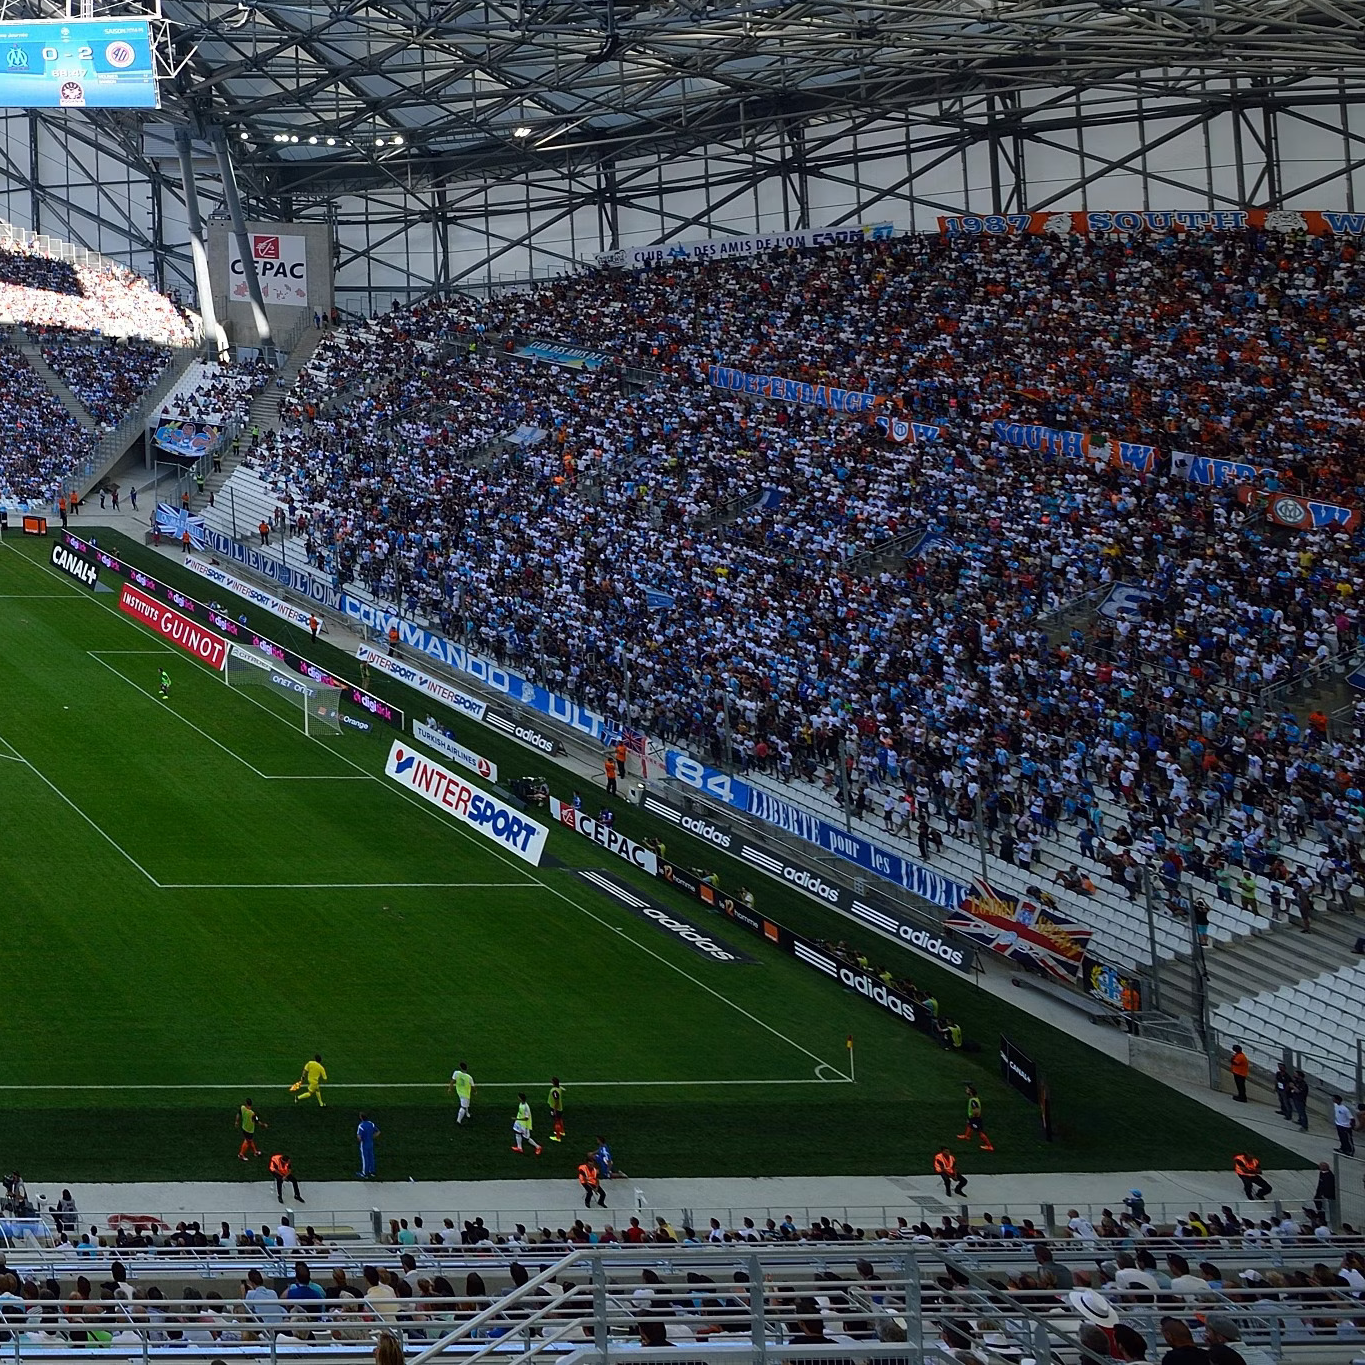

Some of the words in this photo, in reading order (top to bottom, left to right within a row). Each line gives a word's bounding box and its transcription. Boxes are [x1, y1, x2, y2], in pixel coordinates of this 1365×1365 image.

[42, 47, 58, 61] 0
[77, 46, 94, 61] 2
[945, 215, 1030, 235] 1987
[1087, 212, 1248, 233] SOUTH
[634, 250, 663, 262] CLUB
[694, 245, 717, 257] DES
[720, 240, 751, 253] AMIS
[756, 238, 772, 250] DE
[708, 365, 875, 414] INDEPENDANCE
[992, 420, 1085, 458] SOUTH
[70, 537, 87, 553] digitick
[102, 555, 120, 571] digitick
[52, 546, 97, 585] CANAL+
[136, 573, 156, 591] digitick
[190, 560, 226, 582] INTERSPORT
[231, 580, 269, 606] INTERSPORT
[205, 528, 275, 577] ALLEZ
[295, 572, 341, 609] L'OM
[173, 595, 195, 612] digitick
[122, 592, 159, 621] INSTITUTS
[161, 612, 223, 662] GUINOT
[214, 616, 238, 635] digitick
[259, 638, 285, 661] digitick
[272, 675, 291, 688] ONET
[294, 683, 314, 697] ONET
[345, 595, 509, 693] COMMANDO
[675, 756, 734, 802] 84
[368, 651, 417, 682] INTERSPORT
[427, 679, 483, 715] INTERSPORT
[361, 696, 392, 721] digitick
[418, 727, 446, 750] TURKISH
[446, 744, 477, 766] AIRLINES
[515, 726, 554, 752] adidas
[412, 760, 537, 853] INTERSPORT
[579, 815, 646, 868] CEPAC
[748, 786, 820, 845] LIBERTE
[829, 830, 860, 860] pour
[871, 844, 891, 874] les
[901, 859, 971, 912] ULTRAS
[673, 875, 696, 894] homme
[682, 815, 732, 848] adidas
[783, 867, 840, 902] adidas
[899, 924, 964, 965] adidas
[643, 908, 734, 961] adidas
[734, 909, 759, 929] homme
[840, 967, 916, 1023] adidas
